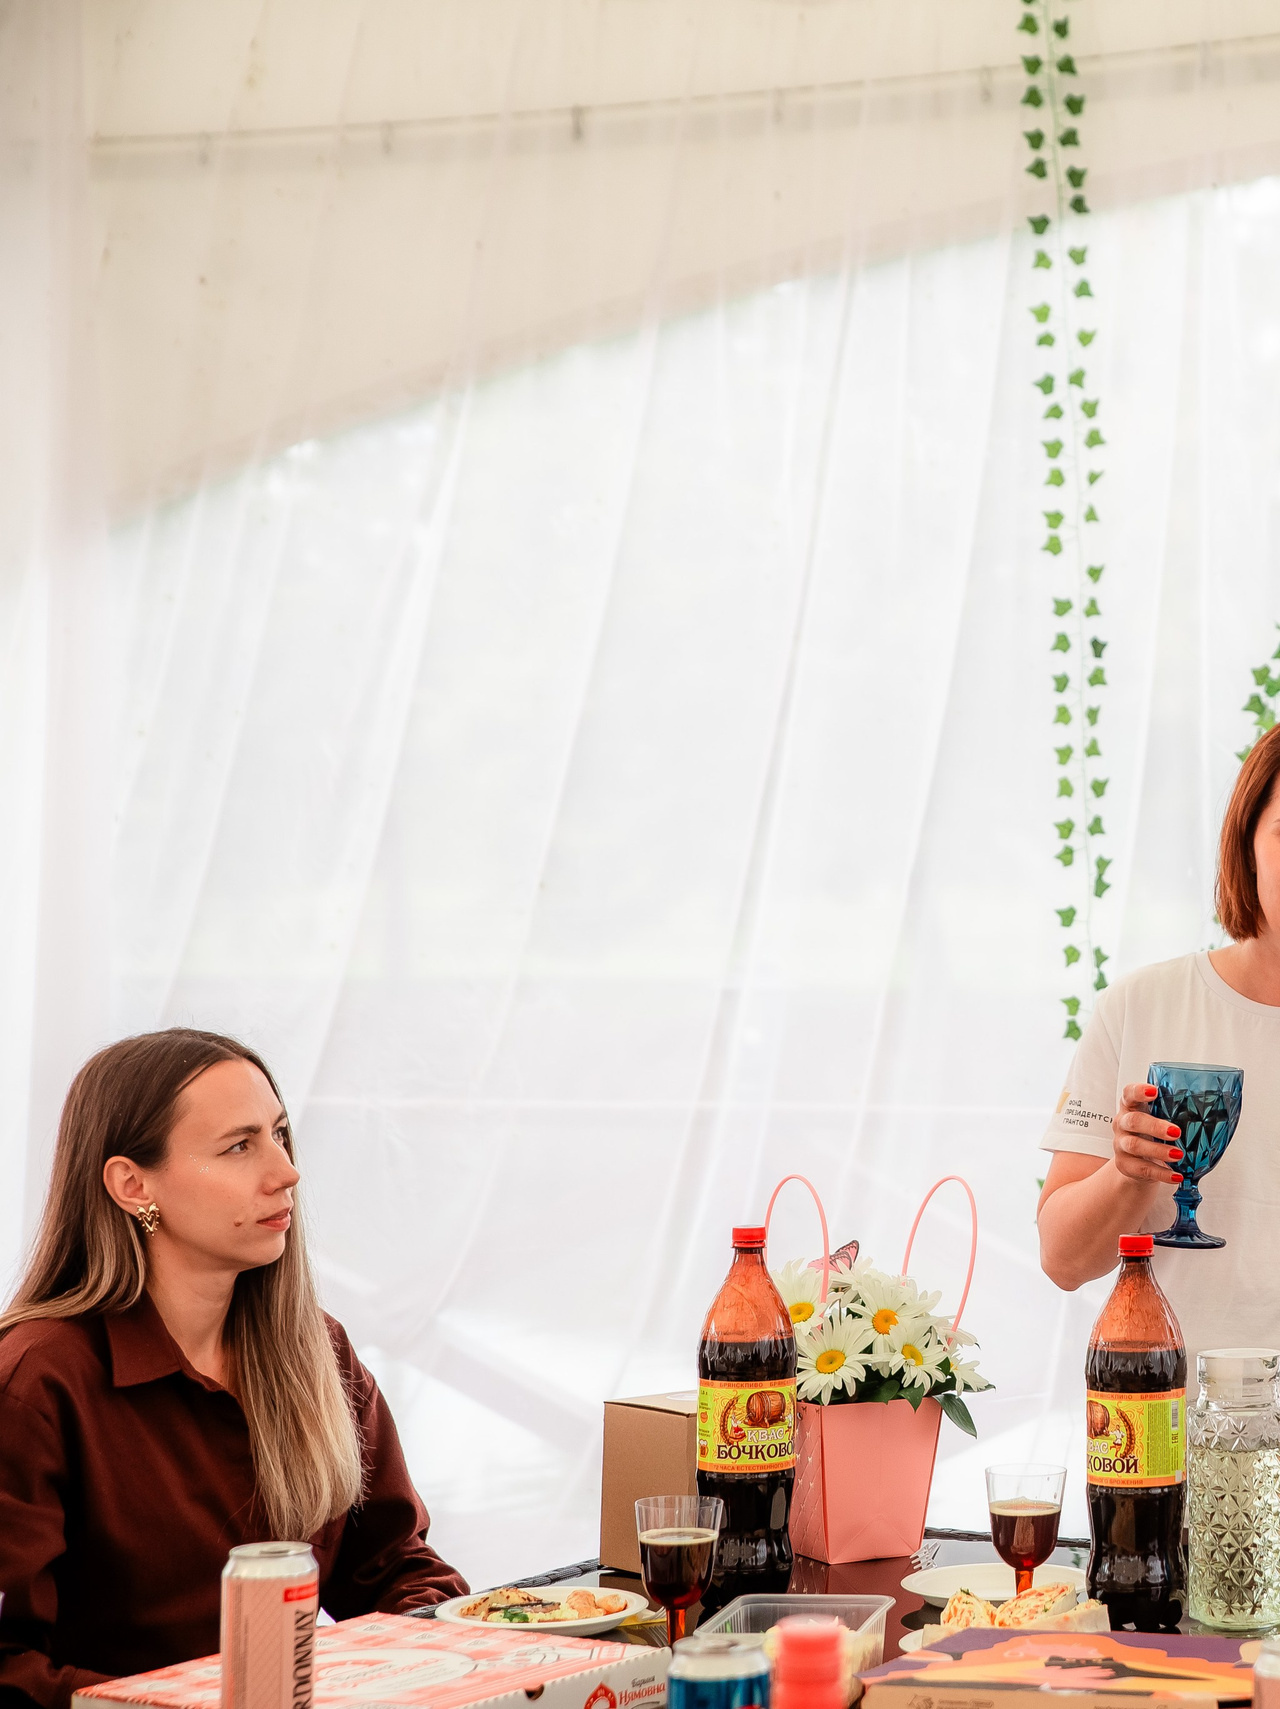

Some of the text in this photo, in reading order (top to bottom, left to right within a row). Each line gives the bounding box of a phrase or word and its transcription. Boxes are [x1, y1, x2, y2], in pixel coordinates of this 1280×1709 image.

[1063, 1117, 1089, 1128] ГРАНТОВ
[1065, 1108, 1113, 1124] ПРЕЗИДЕНТС
[747, 1428, 784, 1443] КВАС
[717, 1441, 795, 1461] БОЧКОВО
[1087, 1439, 1109, 1454] ВАС
[1087, 1455, 1139, 1473] КОВОЙ
[293, 1609, 314, 1709] RDONNAY
